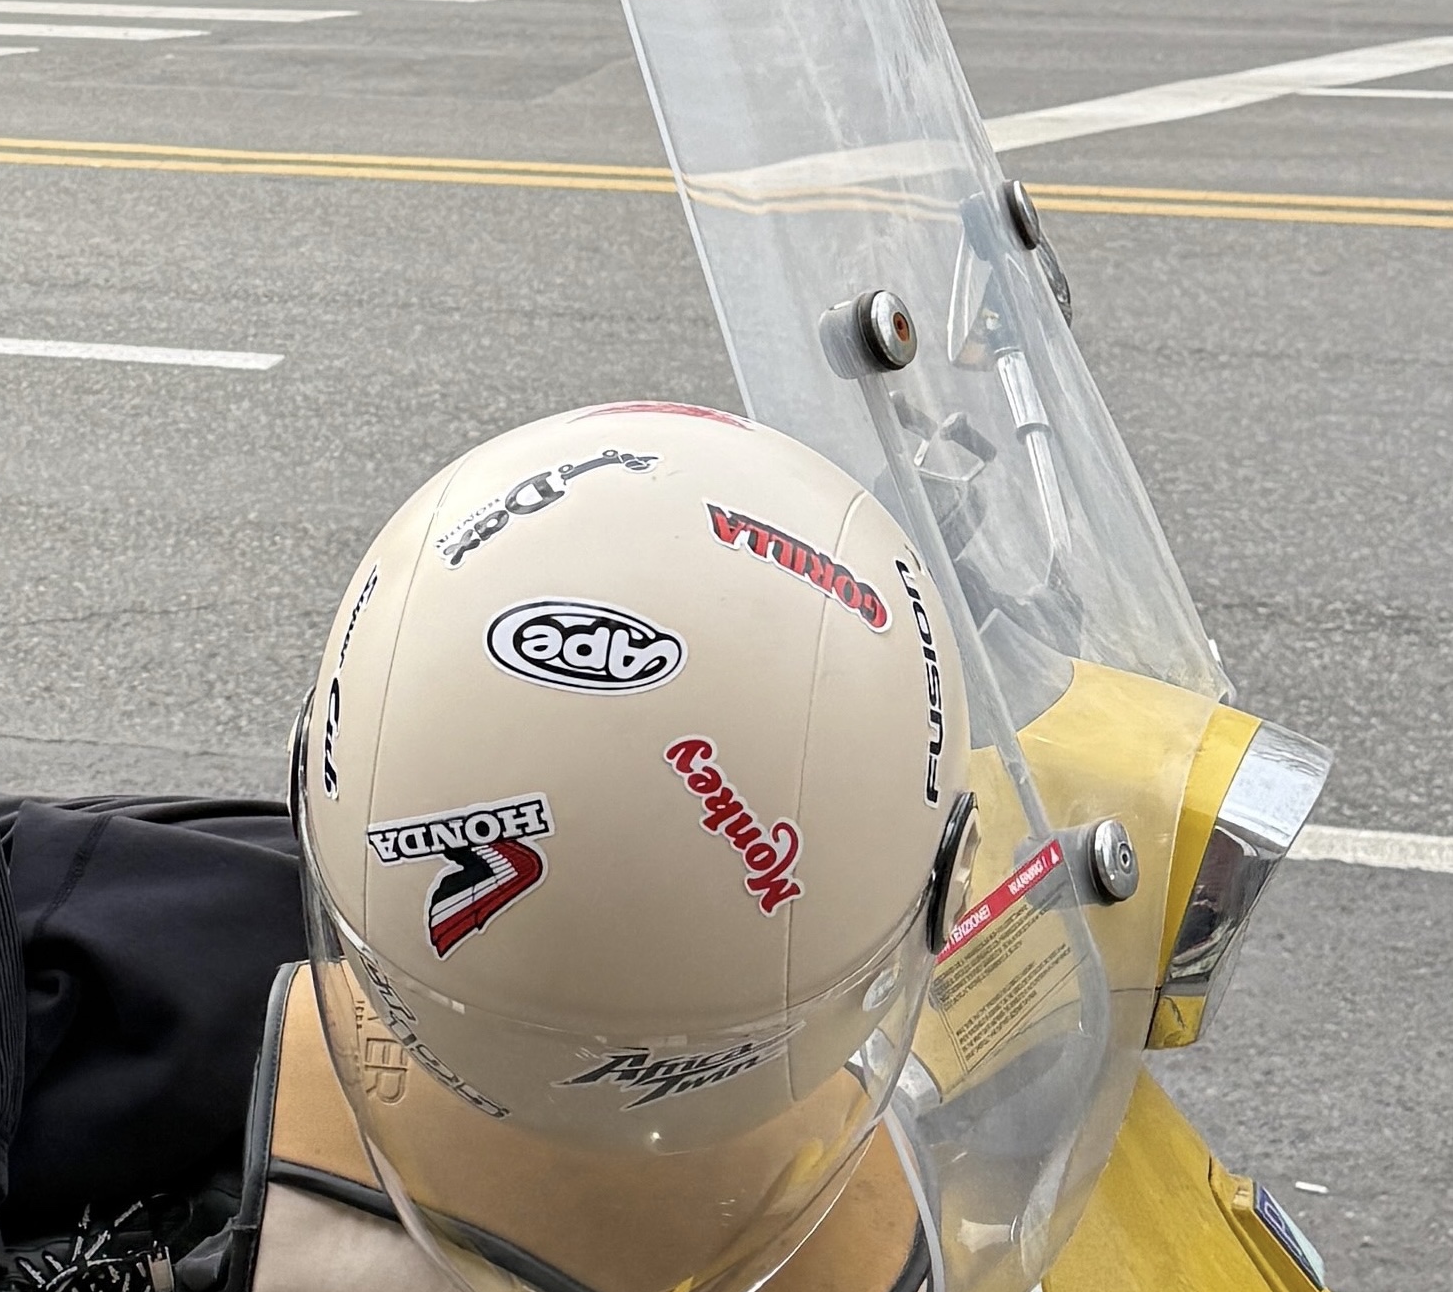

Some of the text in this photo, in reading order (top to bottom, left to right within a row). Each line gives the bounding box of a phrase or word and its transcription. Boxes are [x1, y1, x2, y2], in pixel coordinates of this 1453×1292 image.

[442, 470, 566, 566] Dax
[706, 503, 888, 629] GORILLA
[511, 615, 682, 683] Ape
[368, 800, 549, 862] HONDA
[666, 738, 803, 915] Monkey
